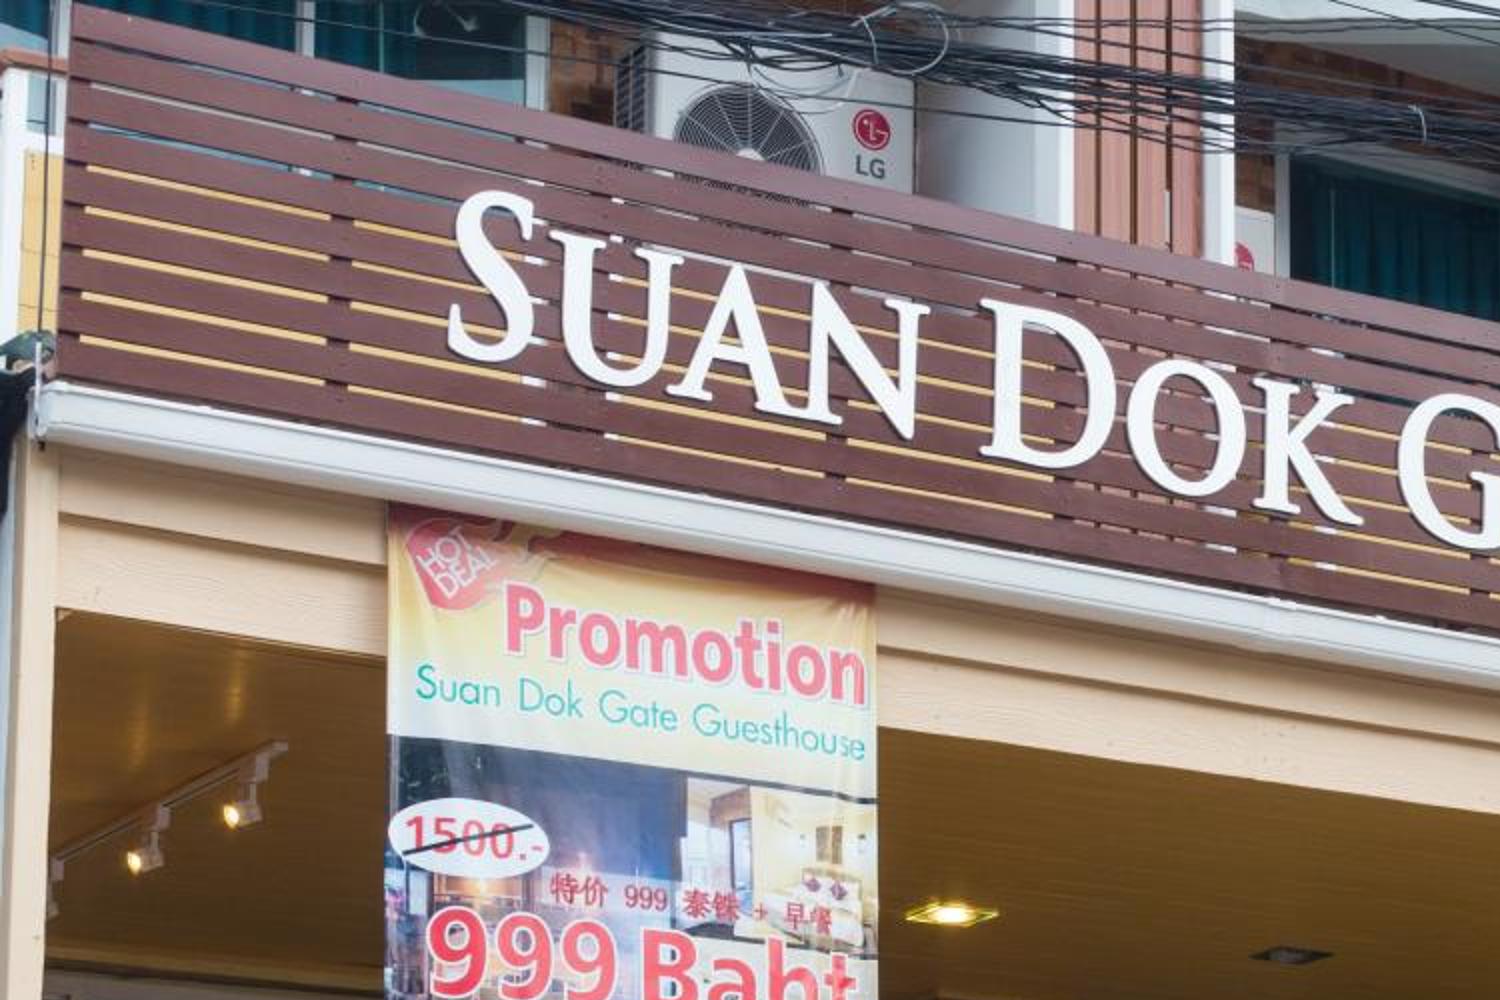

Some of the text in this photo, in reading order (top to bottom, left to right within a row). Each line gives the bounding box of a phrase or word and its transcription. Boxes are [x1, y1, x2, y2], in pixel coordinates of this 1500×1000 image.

[856, 155, 885, 179] LG
[445, 190, 931, 441] SUAN
[980, 297, 1364, 527] DOK
[418, 526, 476, 577] HOT
[438, 545, 496, 598] DEAL
[503, 581, 867, 706] Promotion
[416, 664, 866, 761] Suan Dok Gate Guesthouse
[550, 872, 609, 908] 特价
[624, 884, 668, 912] 999
[783, 901, 834, 935] 早餐
